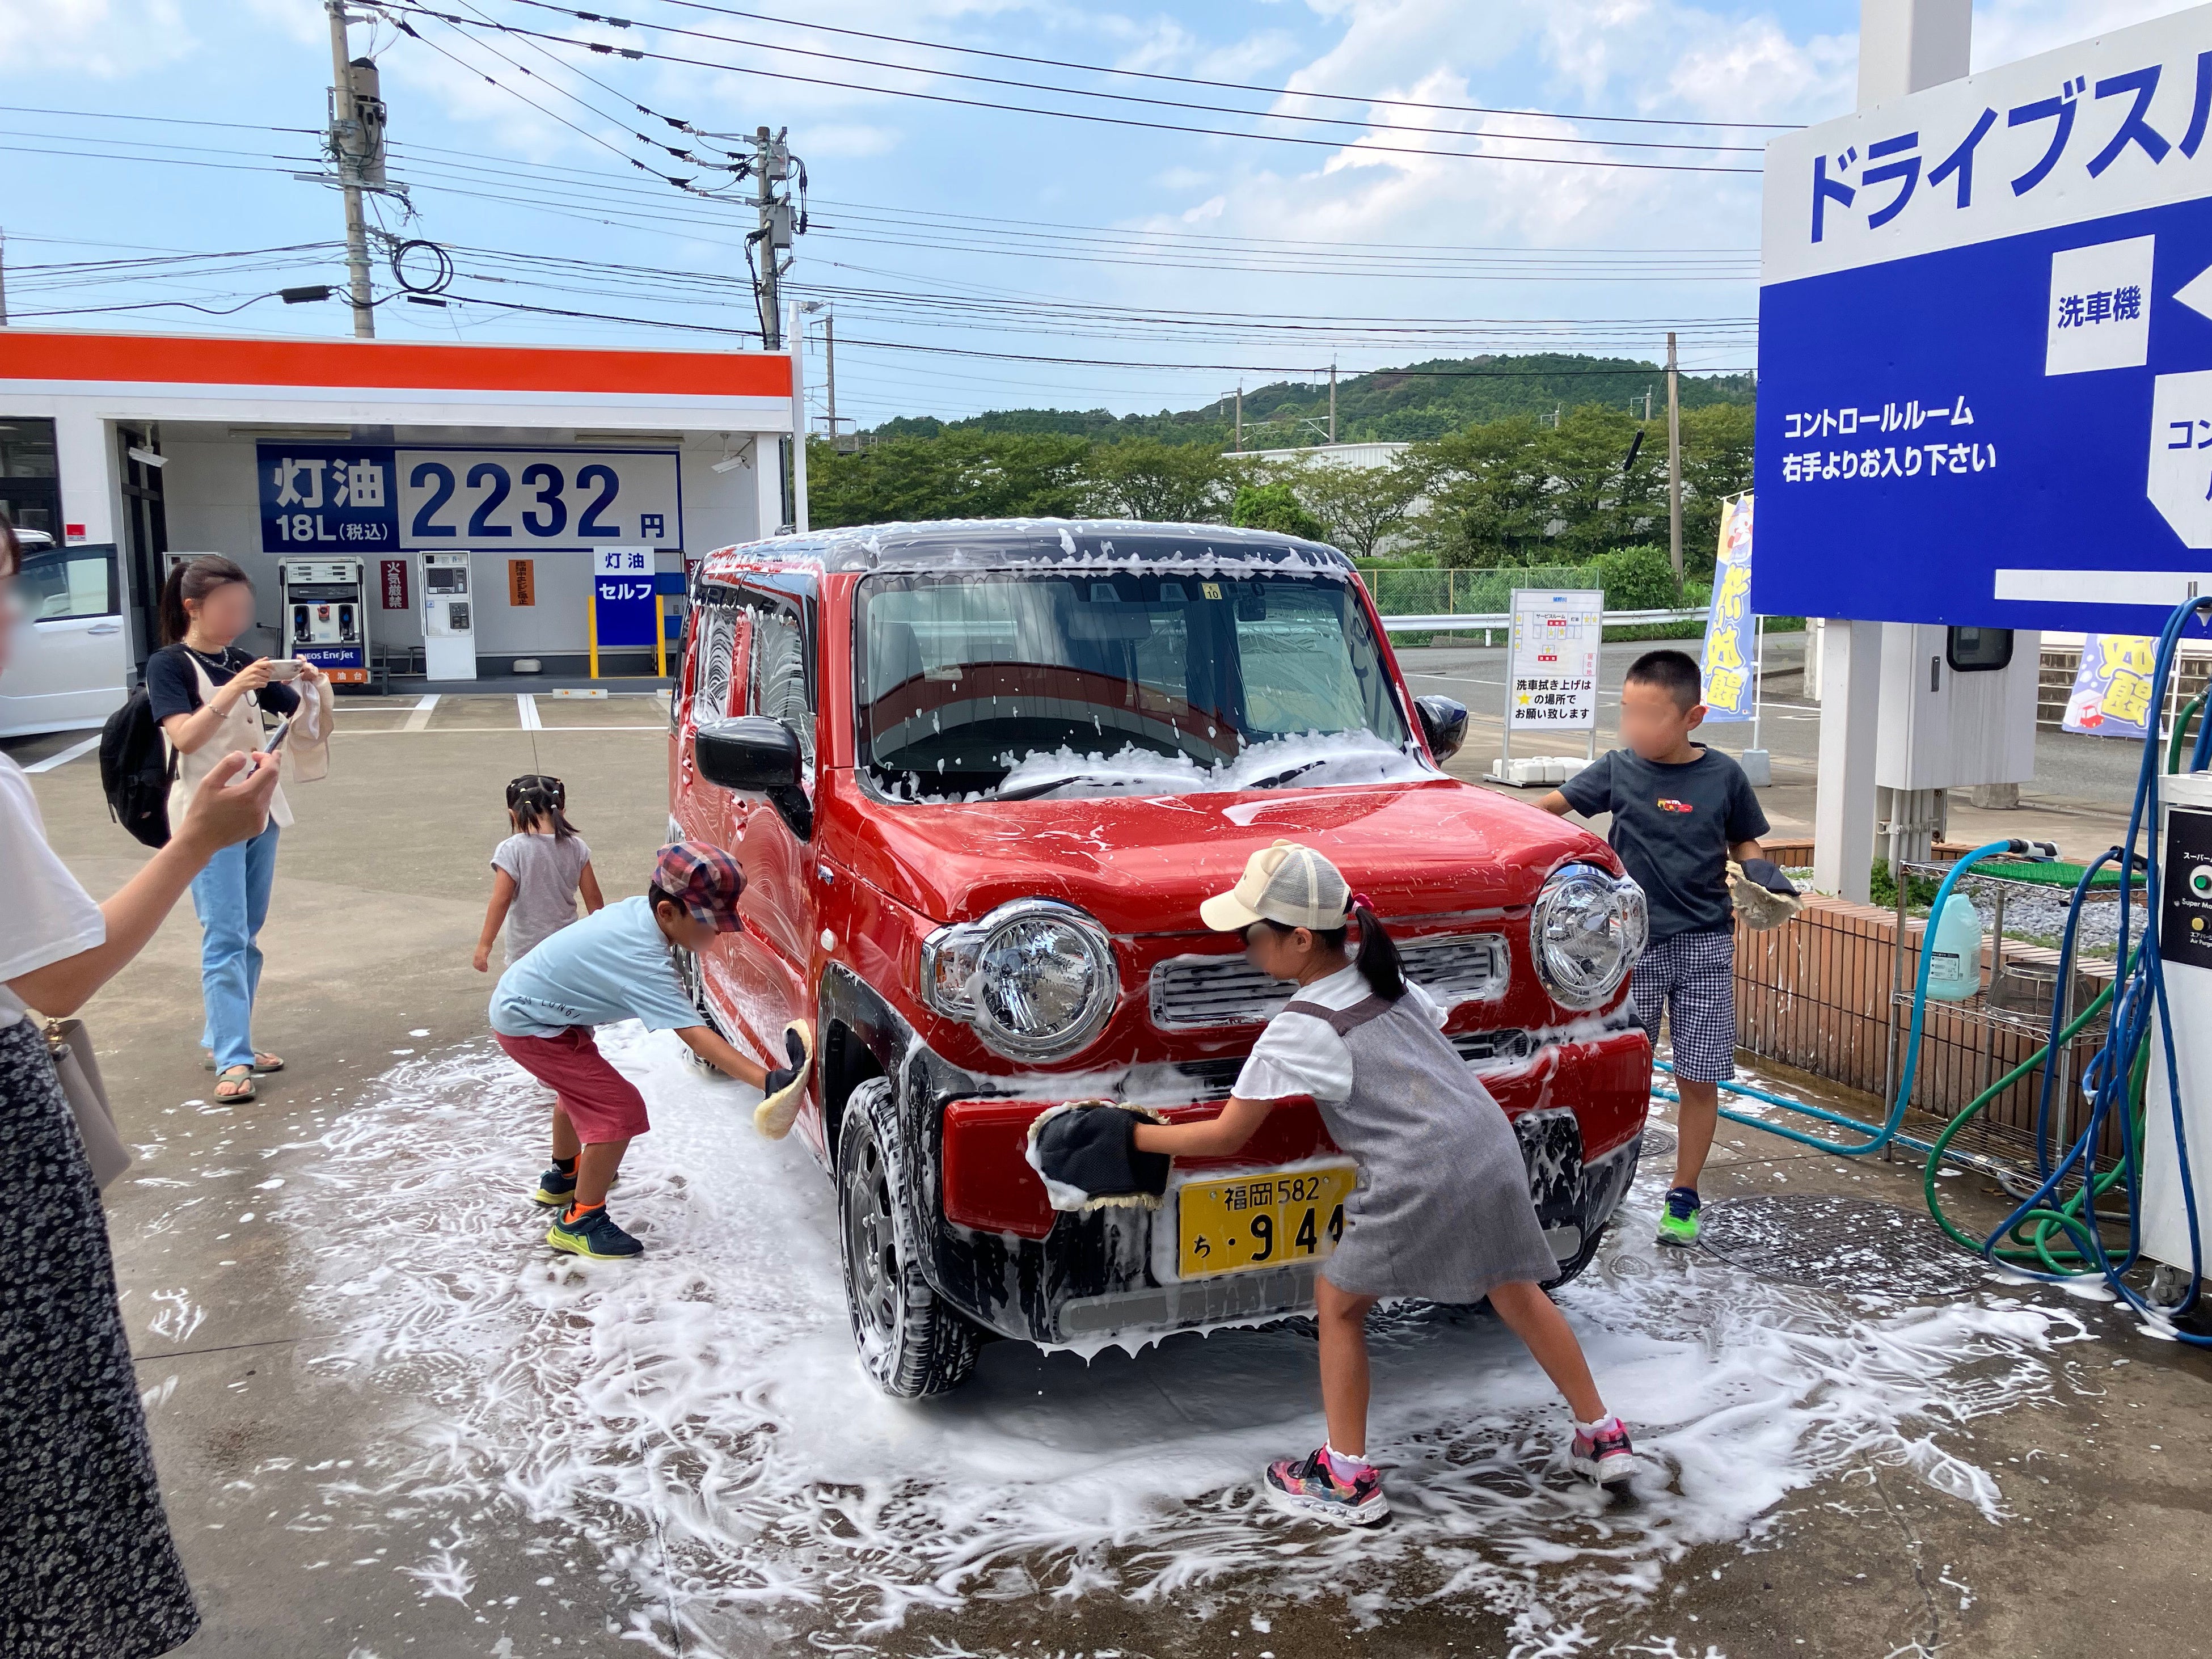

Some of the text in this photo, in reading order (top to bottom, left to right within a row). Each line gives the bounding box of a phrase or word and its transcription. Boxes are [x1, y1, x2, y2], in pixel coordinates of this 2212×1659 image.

[2058, 285, 2141, 328] 洗車機
[1785, 396, 1974, 438] コントロールルーム
[1783, 443, 1996, 482] 右手よりお入り下さい
[273, 458, 385, 508] 灯油
[410, 462, 664, 538] 2232 円
[606, 553, 644, 569] 灯油
[387, 562, 402, 608] 火気厳禁
[599, 584, 652, 600] セルフ
[326, 672, 362, 680] 油台
[1517, 679, 1591, 690] 洗車拭き上げは
[1534, 694, 1576, 705] の場所で
[1516, 708, 1589, 719] お願い致します
[2184, 852, 2212, 862] スーパー
[2182, 898, 2200, 907] Super
[1224, 1177, 1319, 1211] 福岡 582
[1194, 1235, 1211, 1258] ち
